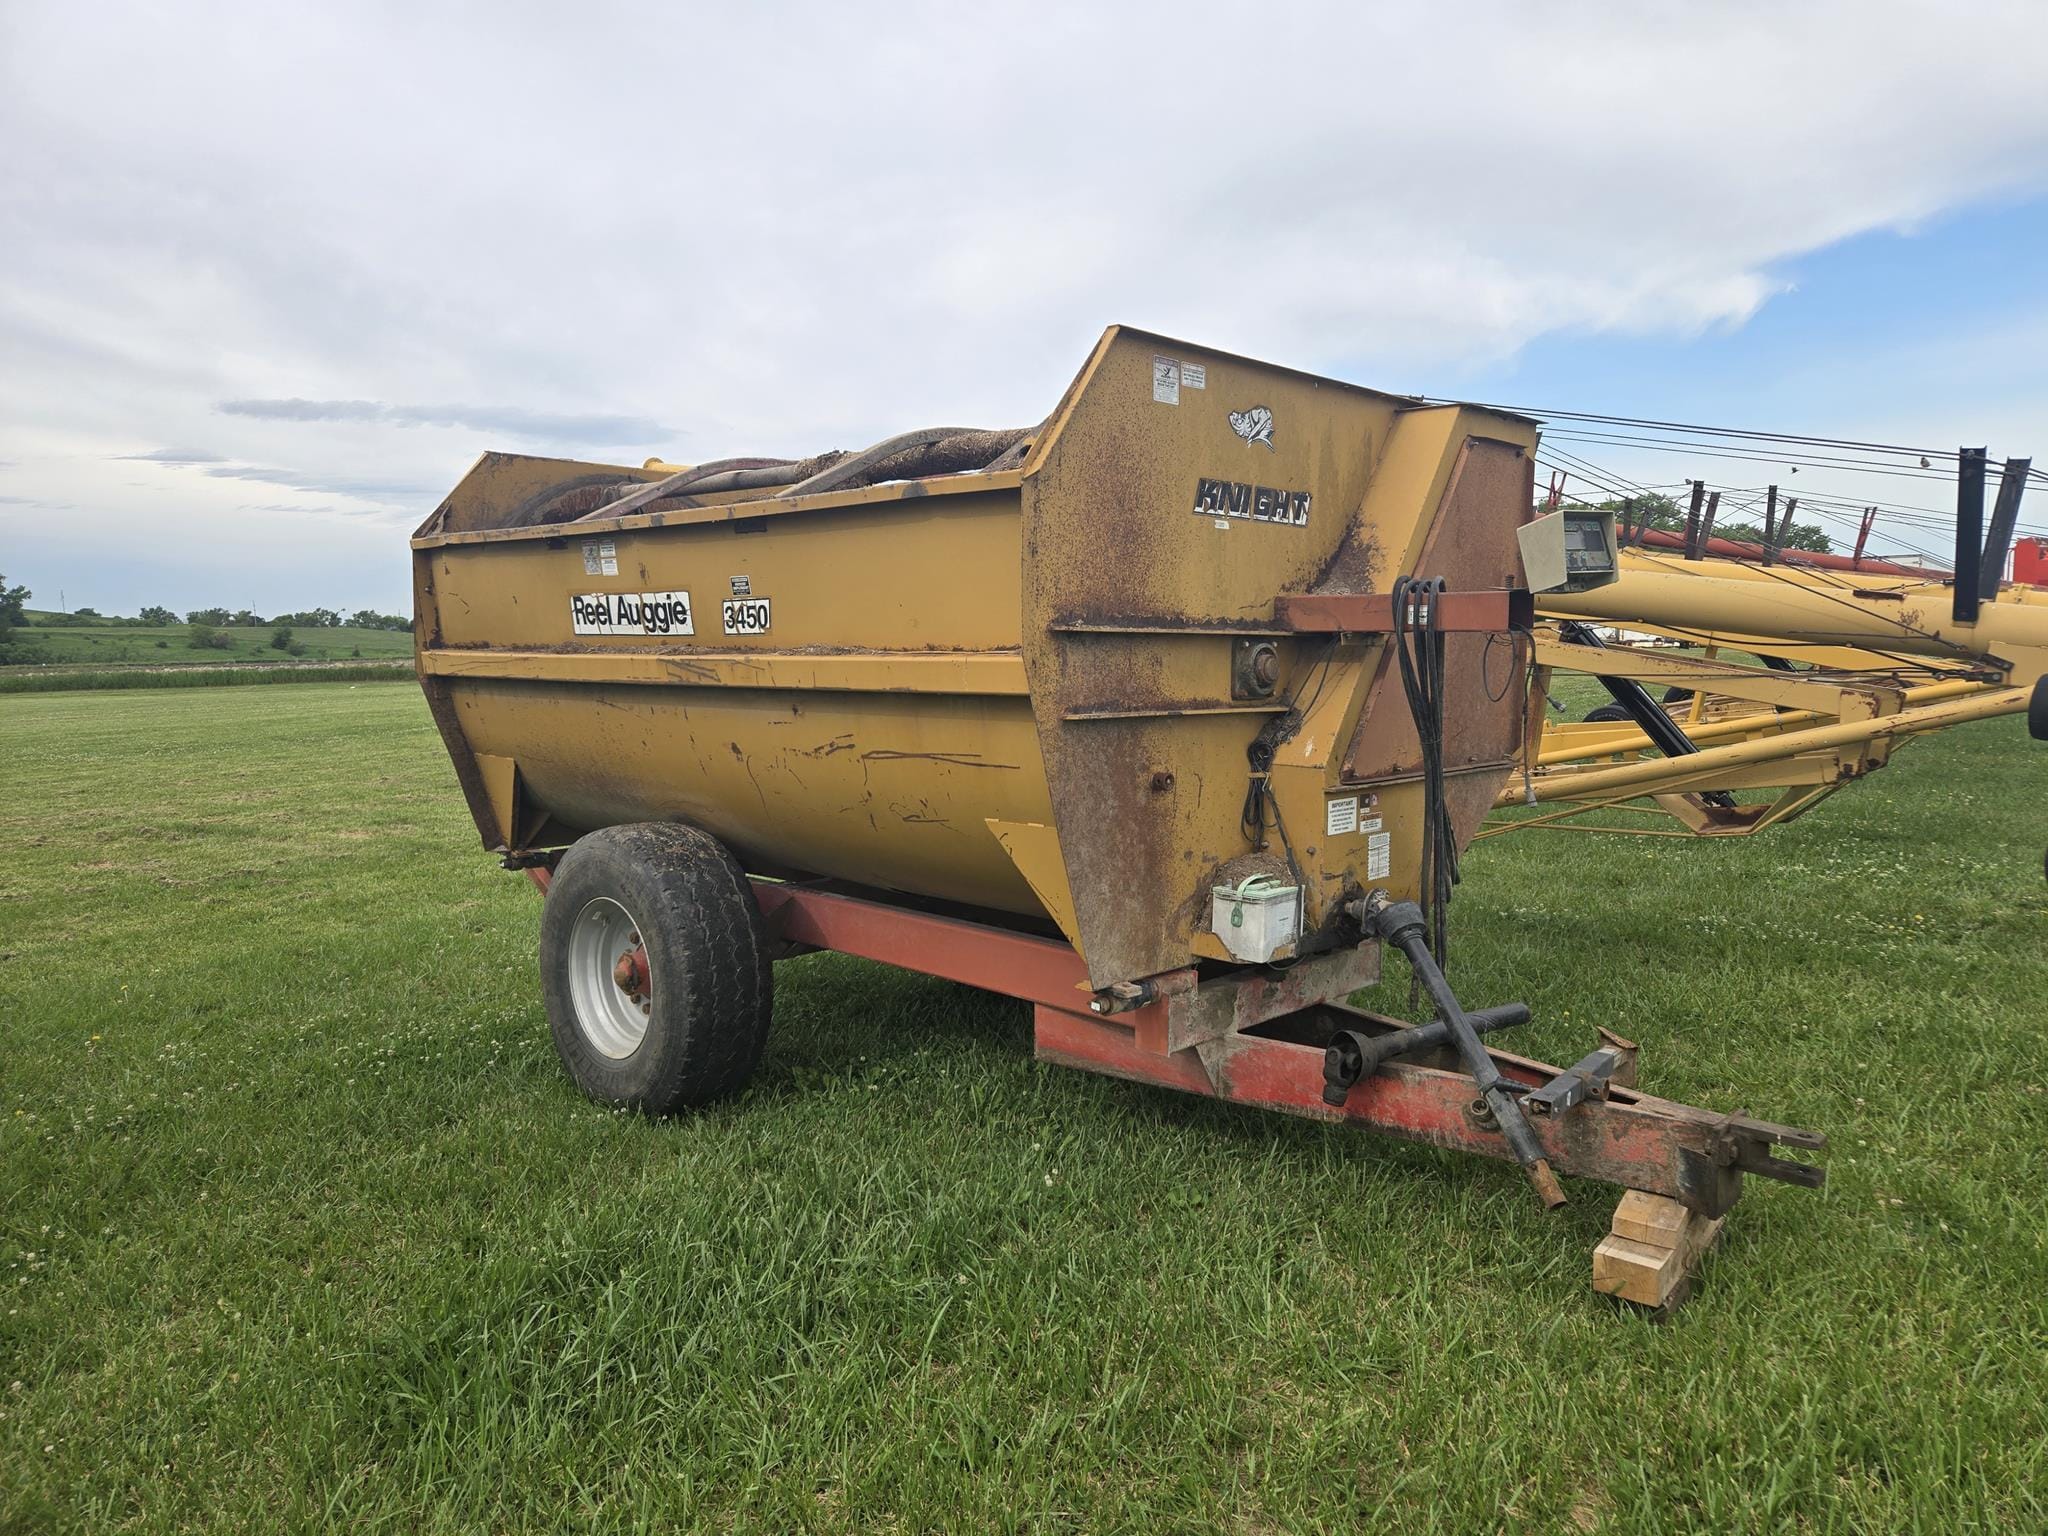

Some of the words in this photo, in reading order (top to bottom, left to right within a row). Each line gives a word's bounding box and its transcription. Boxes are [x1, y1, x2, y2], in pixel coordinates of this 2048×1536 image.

[1196, 478, 1312, 524] KNIGHT
[573, 596, 613, 625] Reel
[617, 593, 688, 634] Auggie
[724, 604, 769, 629] 3450
